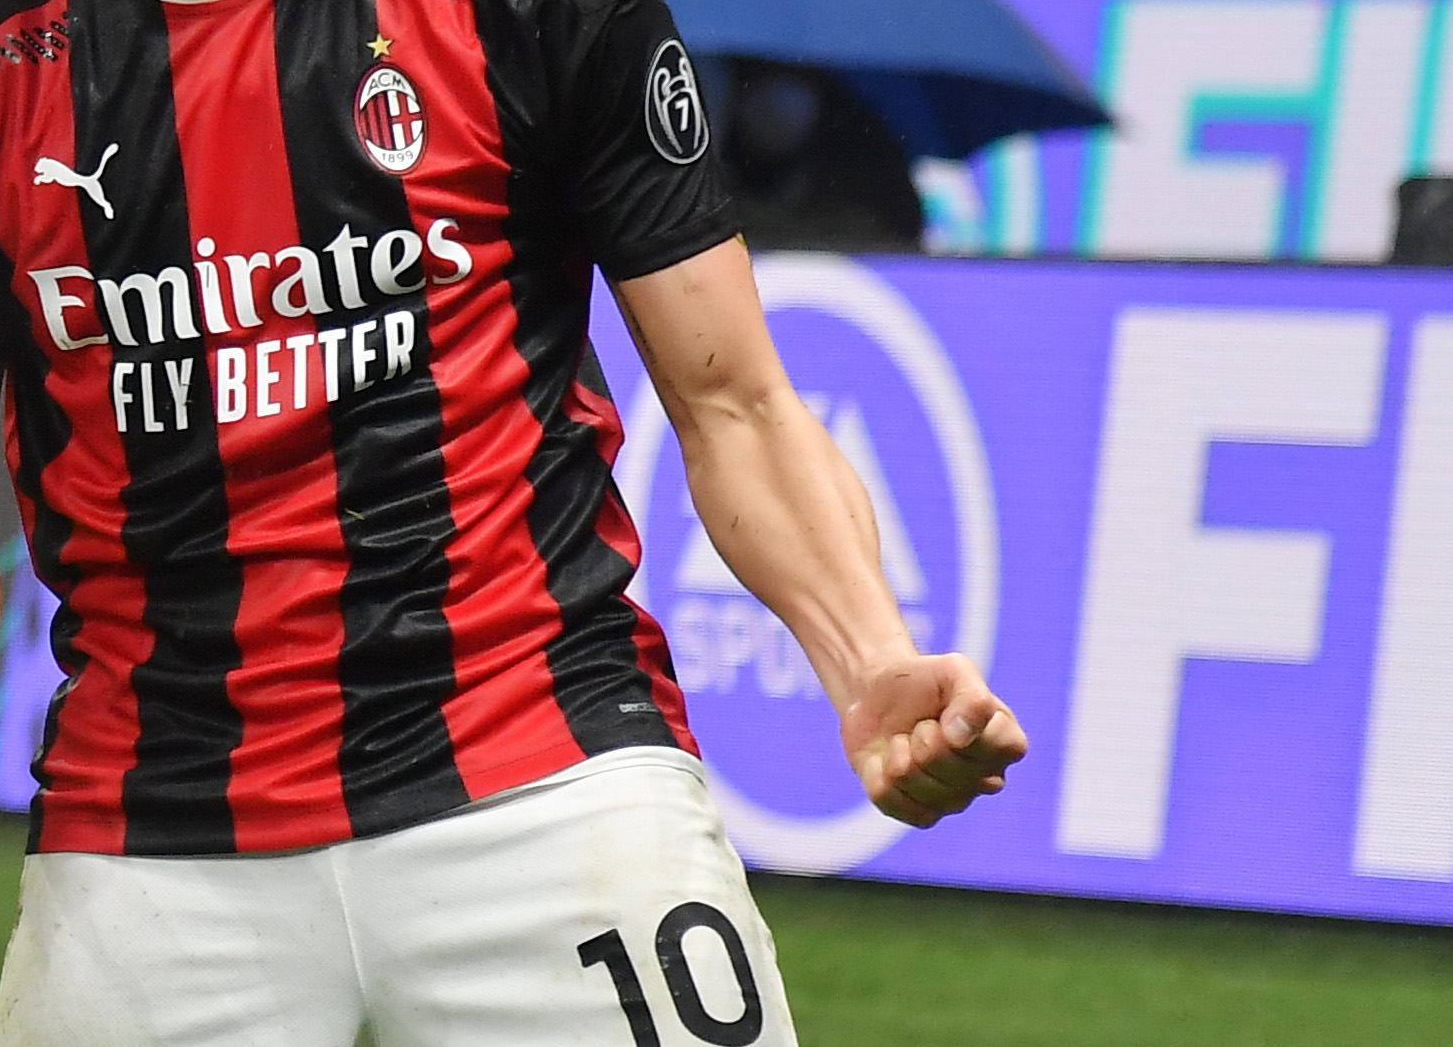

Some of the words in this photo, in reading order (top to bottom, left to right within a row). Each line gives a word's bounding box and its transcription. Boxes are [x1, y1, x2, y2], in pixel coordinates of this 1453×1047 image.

[367, 71, 407, 96] ACM
[382, 150, 415, 164] 1899
[27, 217, 473, 351] Emirates
[112, 358, 194, 433] FLY
[217, 310, 416, 424] BETTER
[577, 901, 762, 1047] 10
